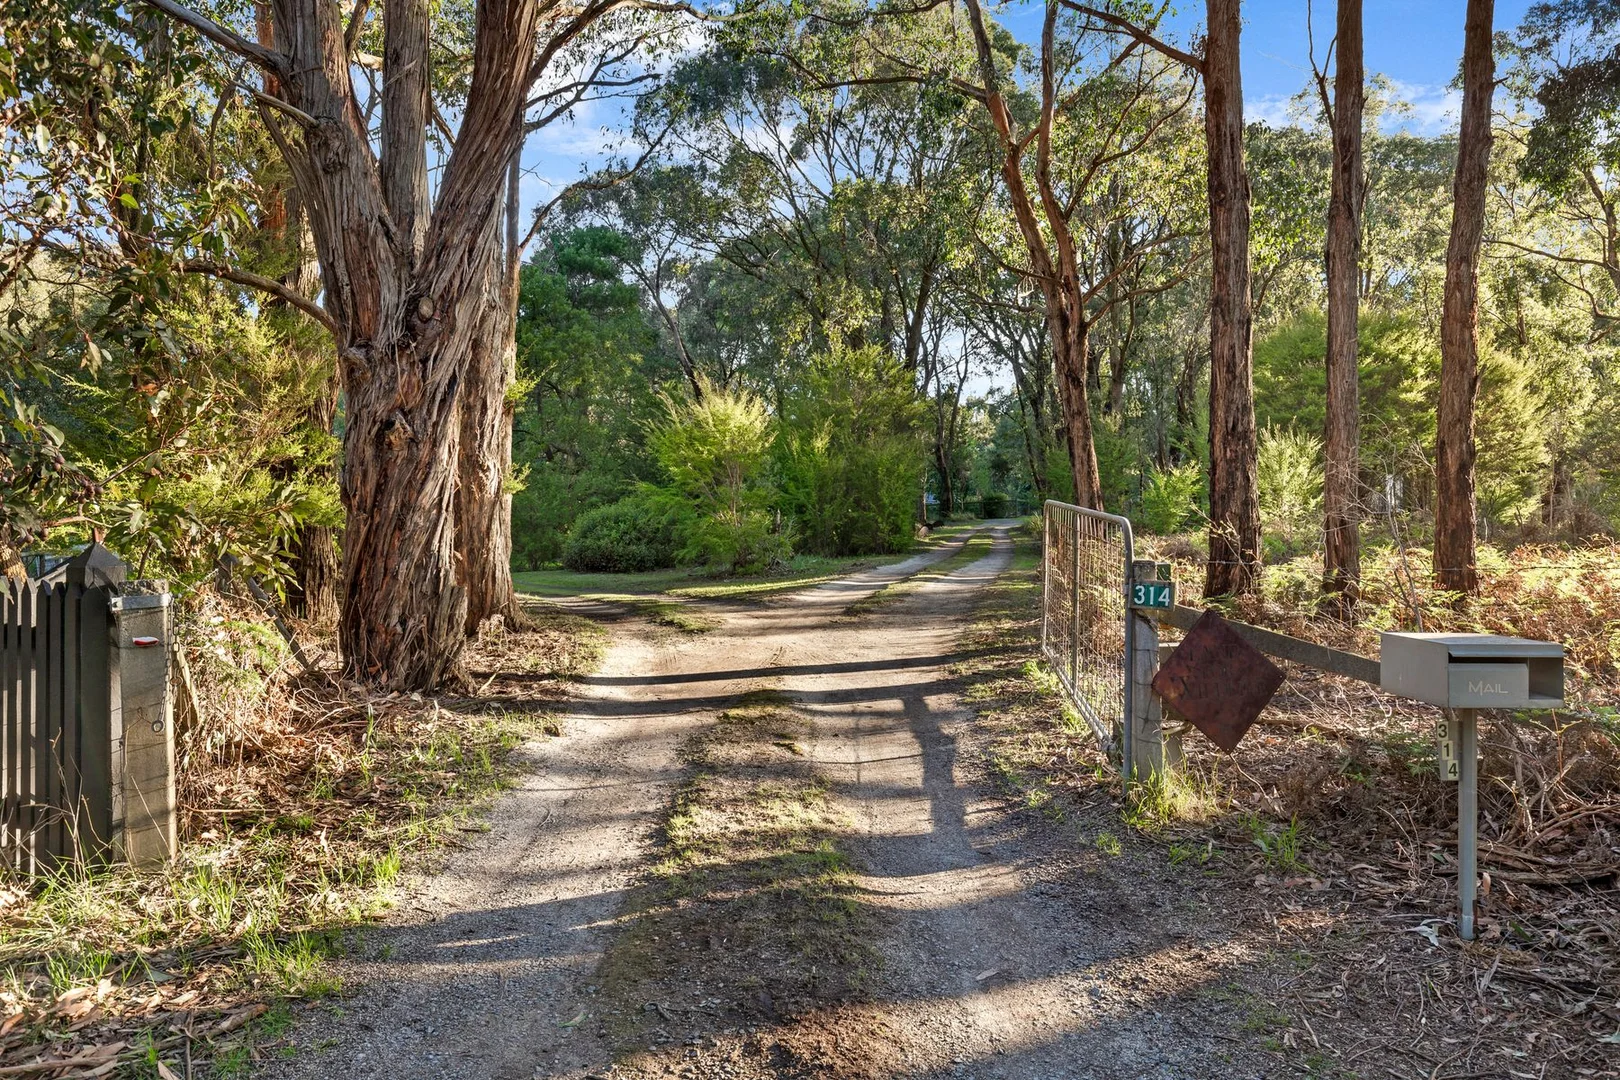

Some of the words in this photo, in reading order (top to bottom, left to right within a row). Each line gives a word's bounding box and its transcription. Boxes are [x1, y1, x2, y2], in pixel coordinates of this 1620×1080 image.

[1134, 585, 1170, 606] 314
[1468, 680, 1509, 696] MAIL
[1438, 724, 1459, 777] 314
